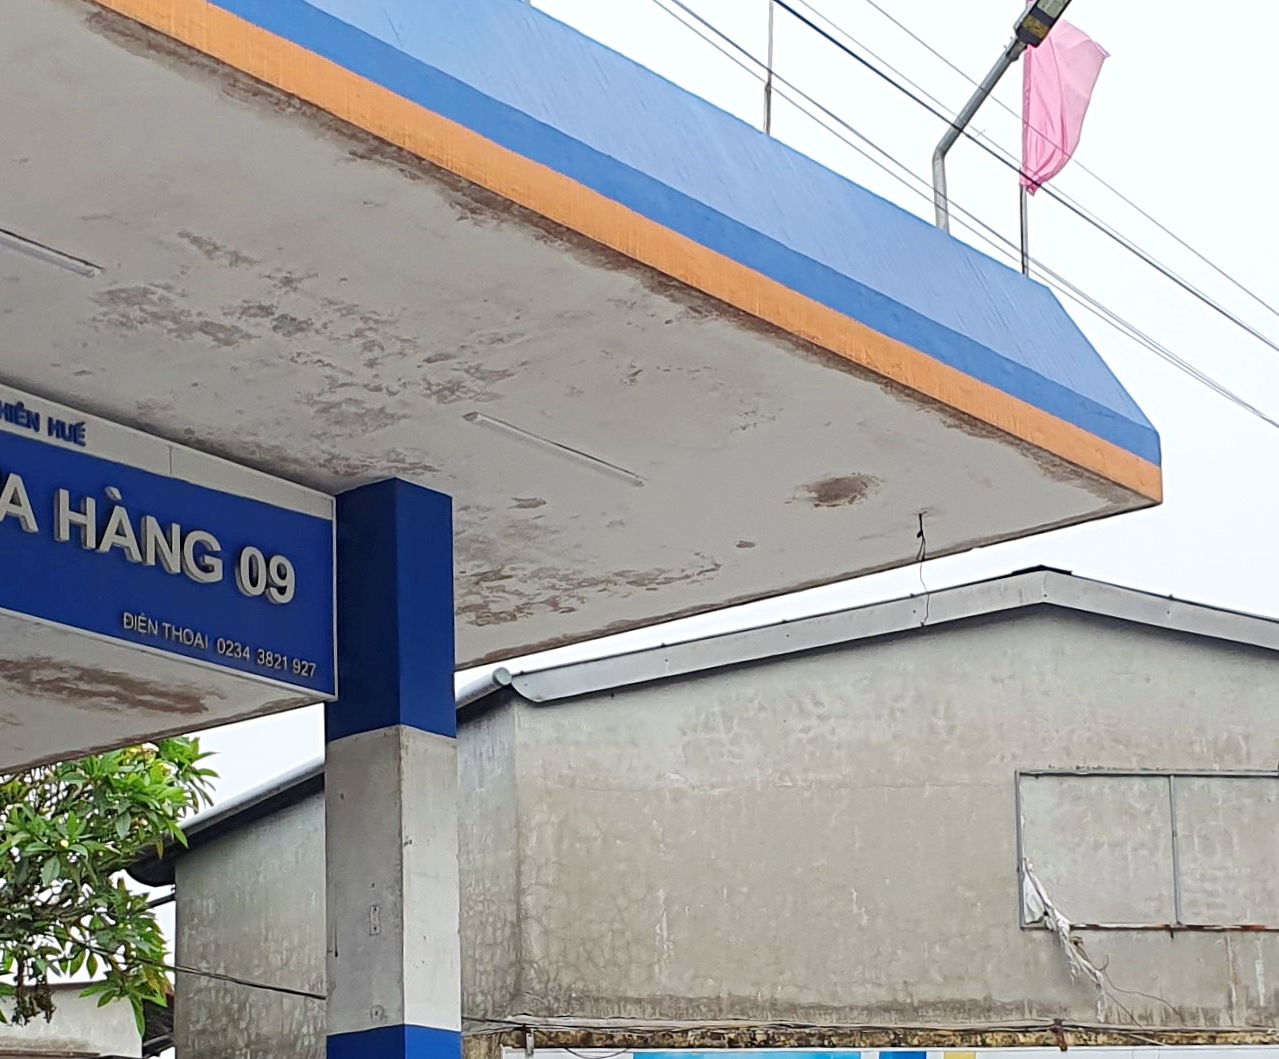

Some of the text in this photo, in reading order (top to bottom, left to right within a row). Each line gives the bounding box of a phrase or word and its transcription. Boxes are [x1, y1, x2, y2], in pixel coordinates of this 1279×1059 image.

[46, 414, 87, 448] HUẾ
[53, 485, 224, 585] HÀNG
[235, 545, 297, 606] 09
[217, 637, 251, 662] 0234
[257, 648, 289, 670] 3821
[292, 658, 317, 678] 927
